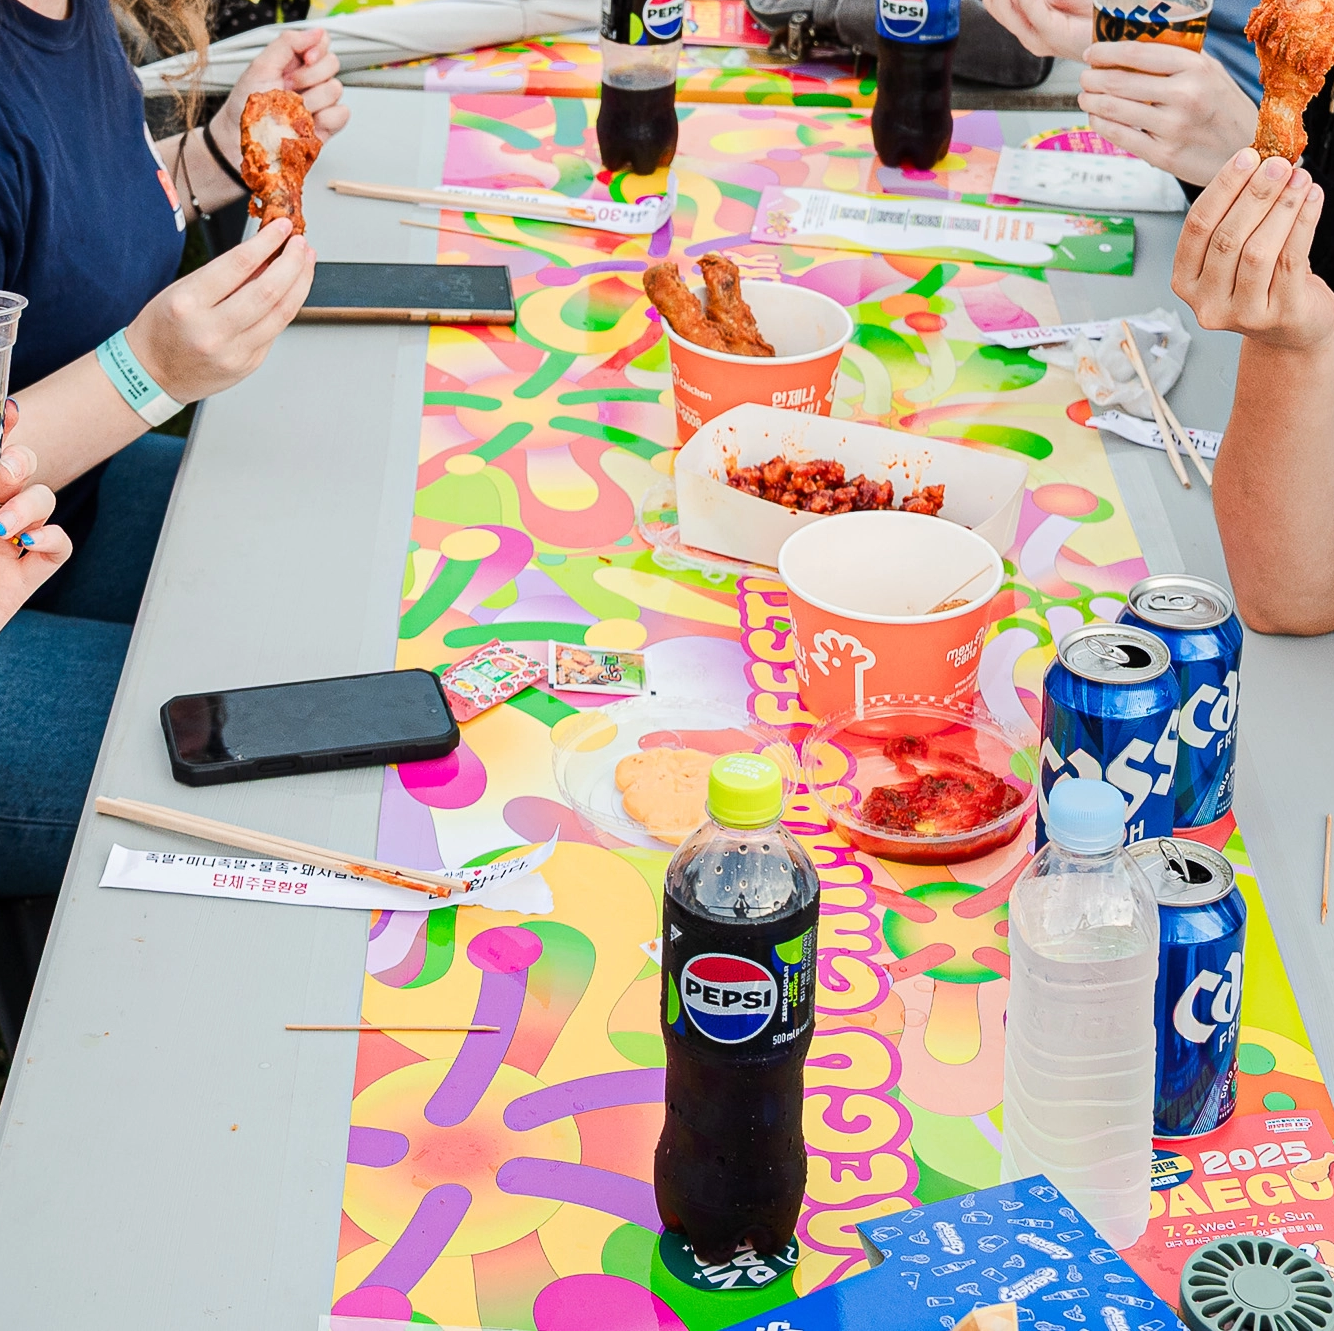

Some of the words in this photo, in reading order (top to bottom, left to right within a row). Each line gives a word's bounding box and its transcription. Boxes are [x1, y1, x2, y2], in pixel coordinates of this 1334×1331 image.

[882, 0, 924, 18] PEPSI
[679, 378, 712, 401] Chicken
[771, 384, 816, 408] 언제나
[947, 634, 974, 662] mexi
[722, 765, 760, 781] SUGAR
[726, 755, 772, 771] PEPSI
[729, 762, 760, 773] ZERO
[1217, 770, 1232, 798] COLD
[212, 872, 309, 896] 단체주문환영
[782, 964, 790, 999] SUGAR
[685, 977, 772, 1010] PEPSI
[781, 1000, 789, 1024] ZERO
[772, 1031, 786, 1047] 500
[1220, 1068, 1235, 1101] COLD
[1151, 1158, 1180, 1176] 치맥
[1199, 1141, 1312, 1176] 2025
[1163, 1225, 1181, 1238] 7.
[1165, 1238, 1184, 1250] 대구
[1185, 1236, 1213, 1248] 달서구
